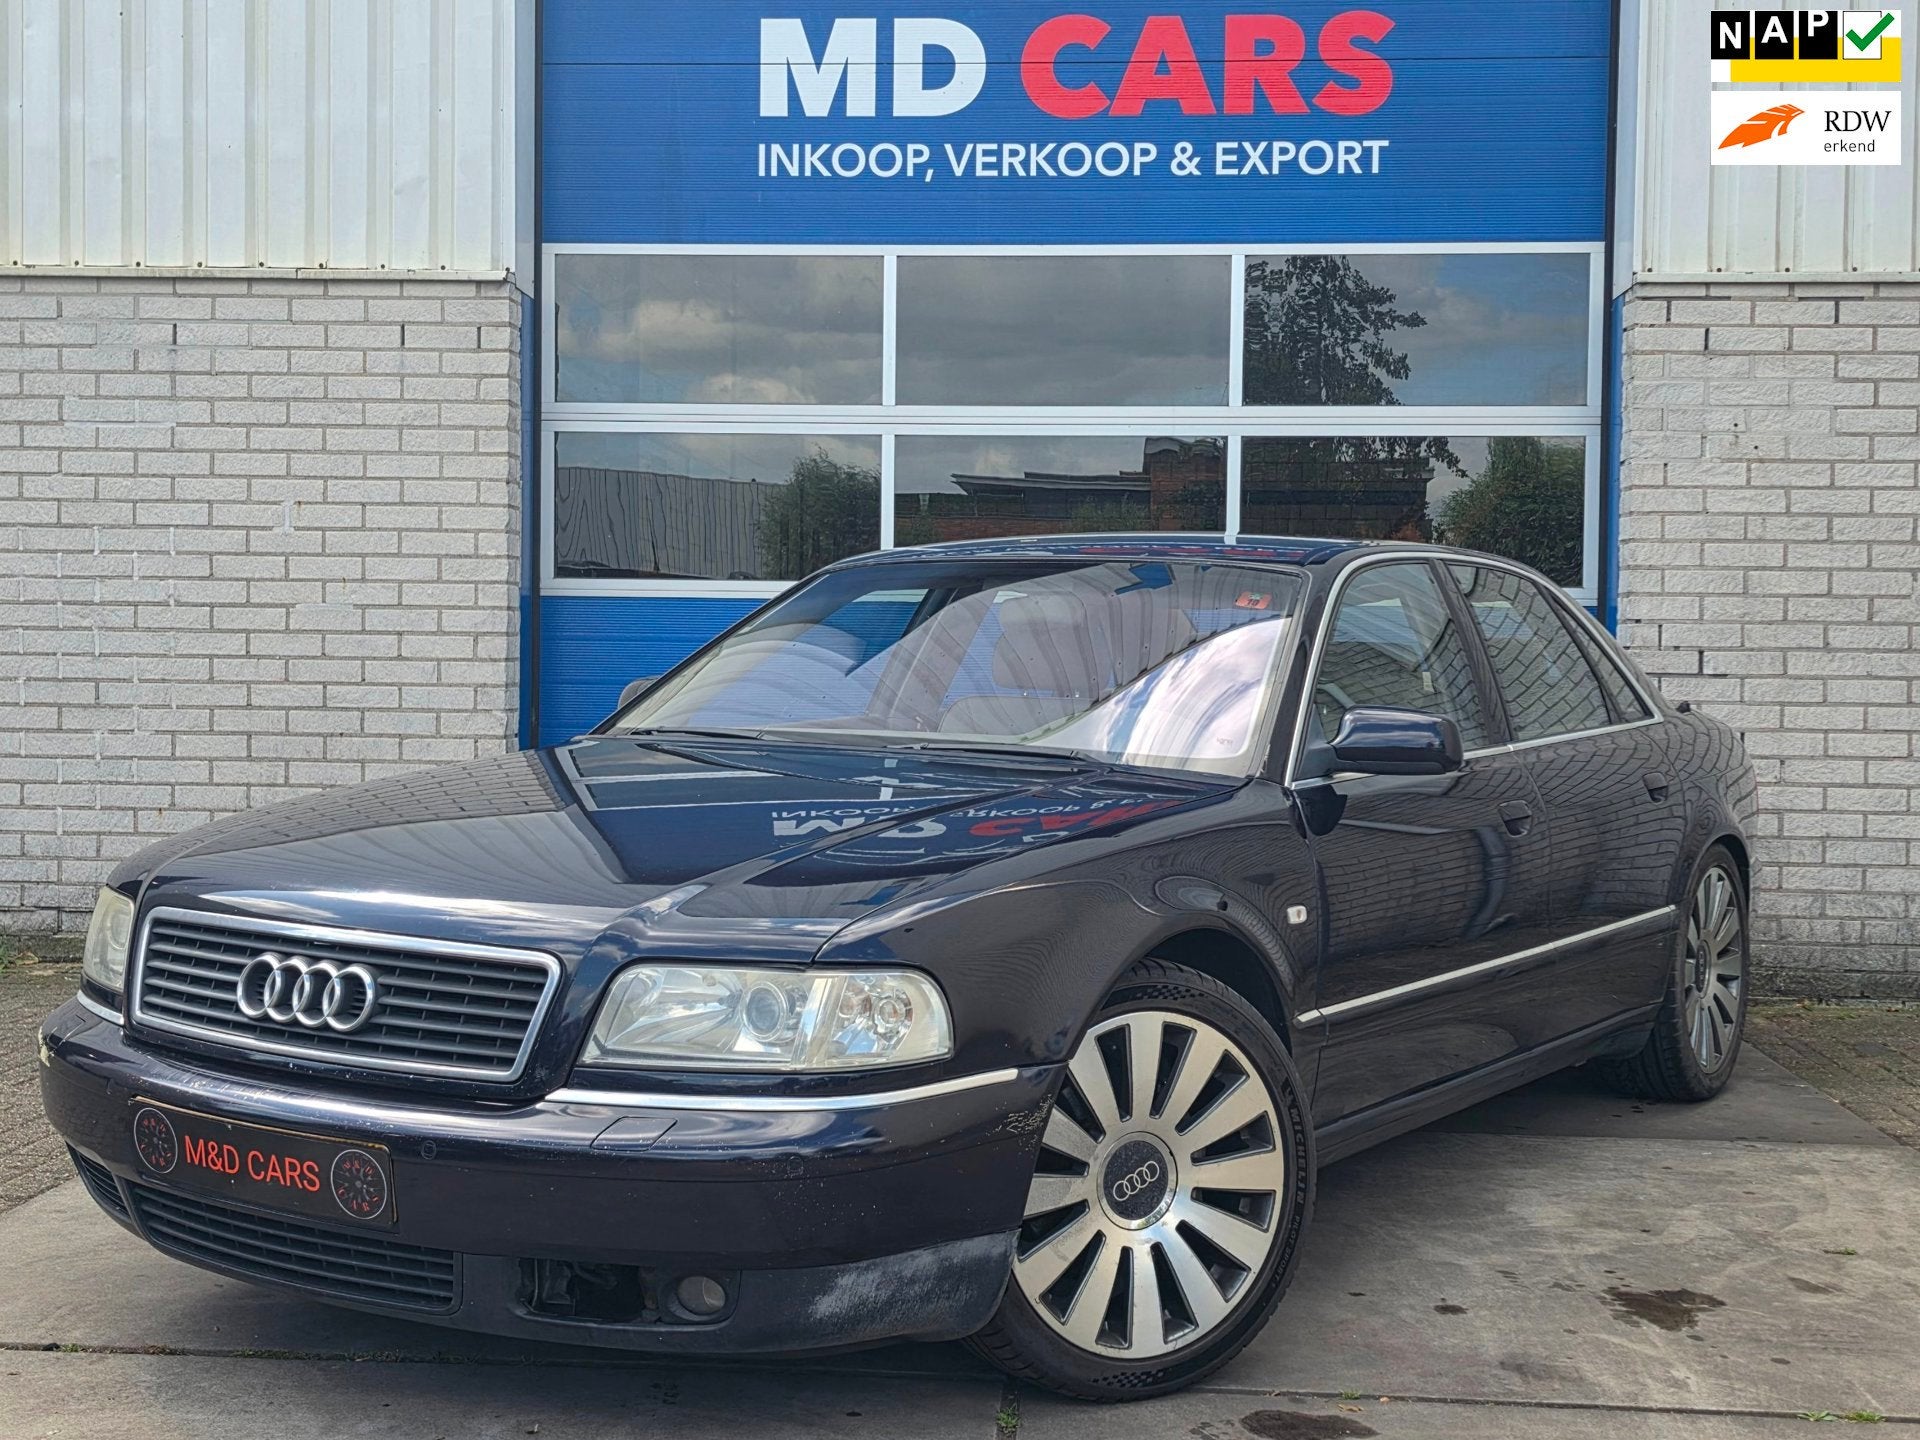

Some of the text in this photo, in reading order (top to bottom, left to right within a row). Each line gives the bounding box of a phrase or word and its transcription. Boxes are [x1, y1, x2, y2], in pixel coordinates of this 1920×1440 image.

[759, 10, 1396, 118] MD CARS
[757, 139, 1389, 183] INKOOP, VERKOOP & EXPORT
[184, 1135, 240, 1174] M&D
[247, 1150, 321, 1192] CARS
[1289, 1108, 1307, 1205] MICHELIN
